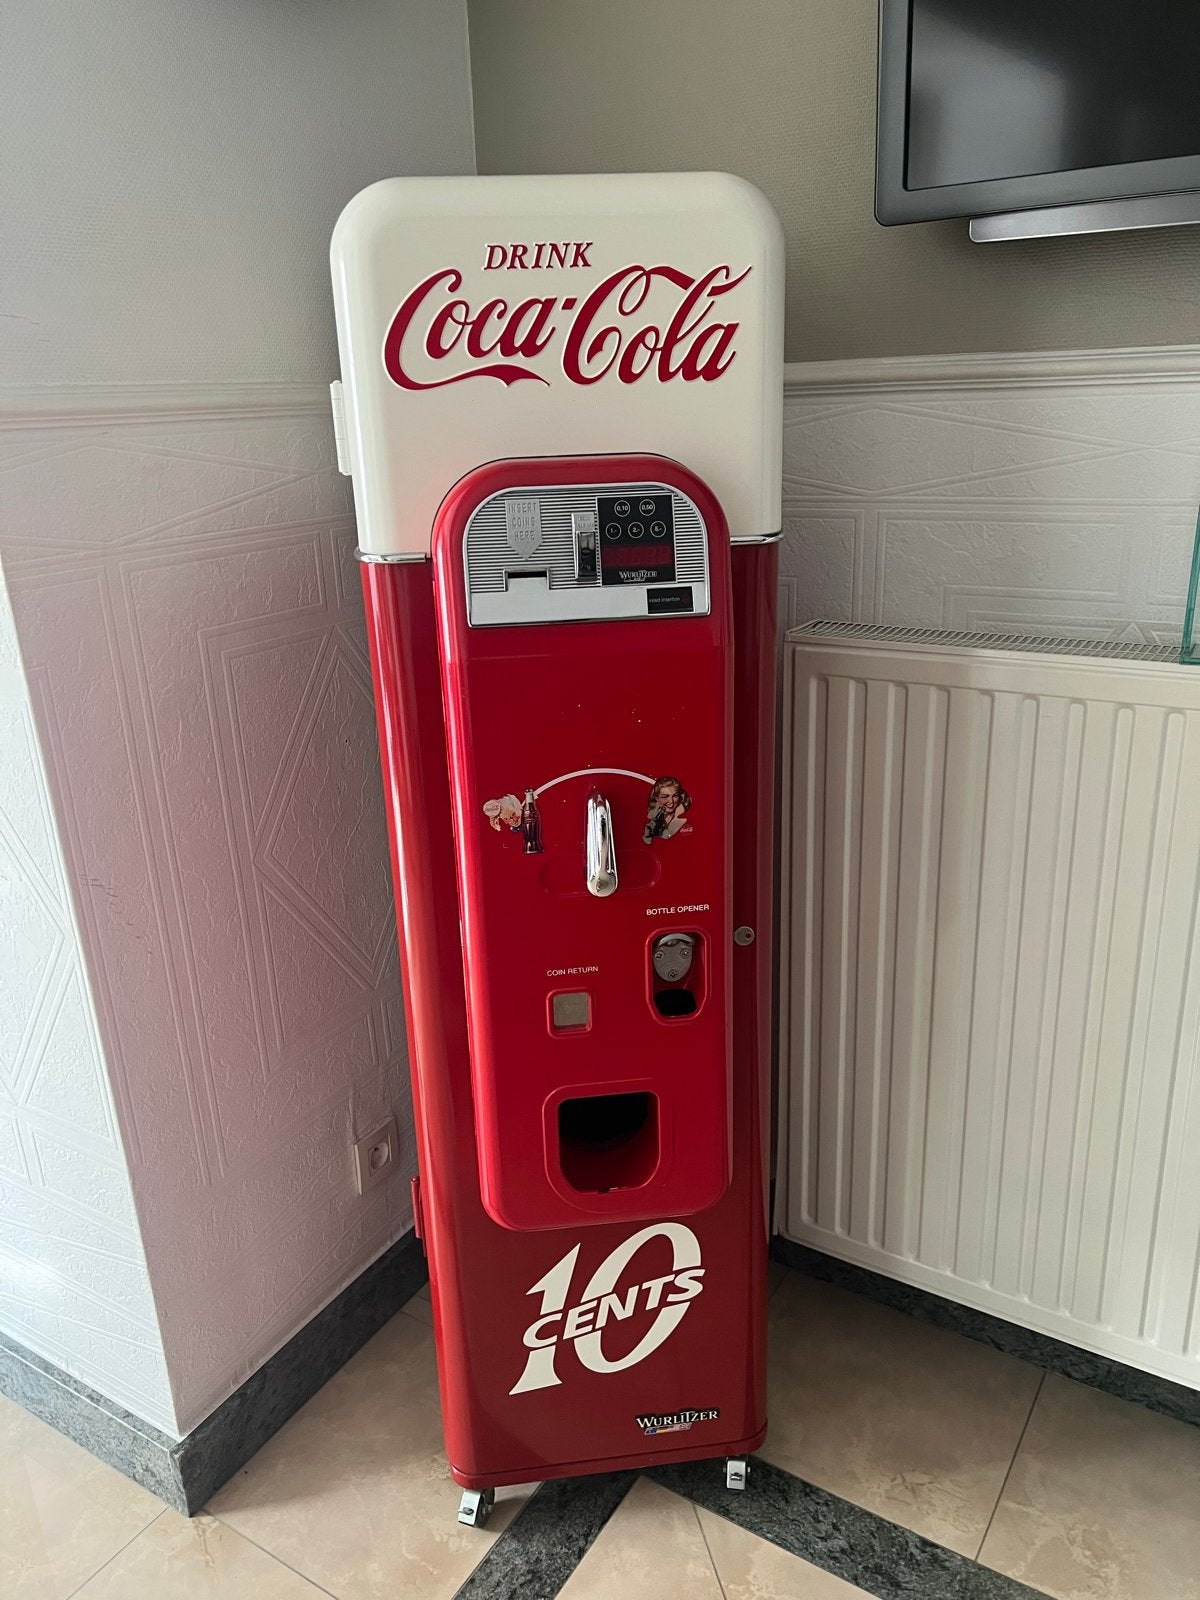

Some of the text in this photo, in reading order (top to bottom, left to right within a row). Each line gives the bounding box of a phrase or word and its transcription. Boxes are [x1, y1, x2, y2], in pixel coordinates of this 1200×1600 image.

[483, 241, 593, 270] DRINK
[384, 264, 752, 391] Coca-Cola
[508, 502, 537, 514] INSERT
[512, 516, 535, 528] COINS
[514, 530, 535, 541] HERE
[646, 903, 710, 916] BOTTLE OPENER
[546, 966, 599, 977] COIN RETURN
[508, 1222, 702, 1396] 10
[522, 1268, 706, 1348] CENTS
